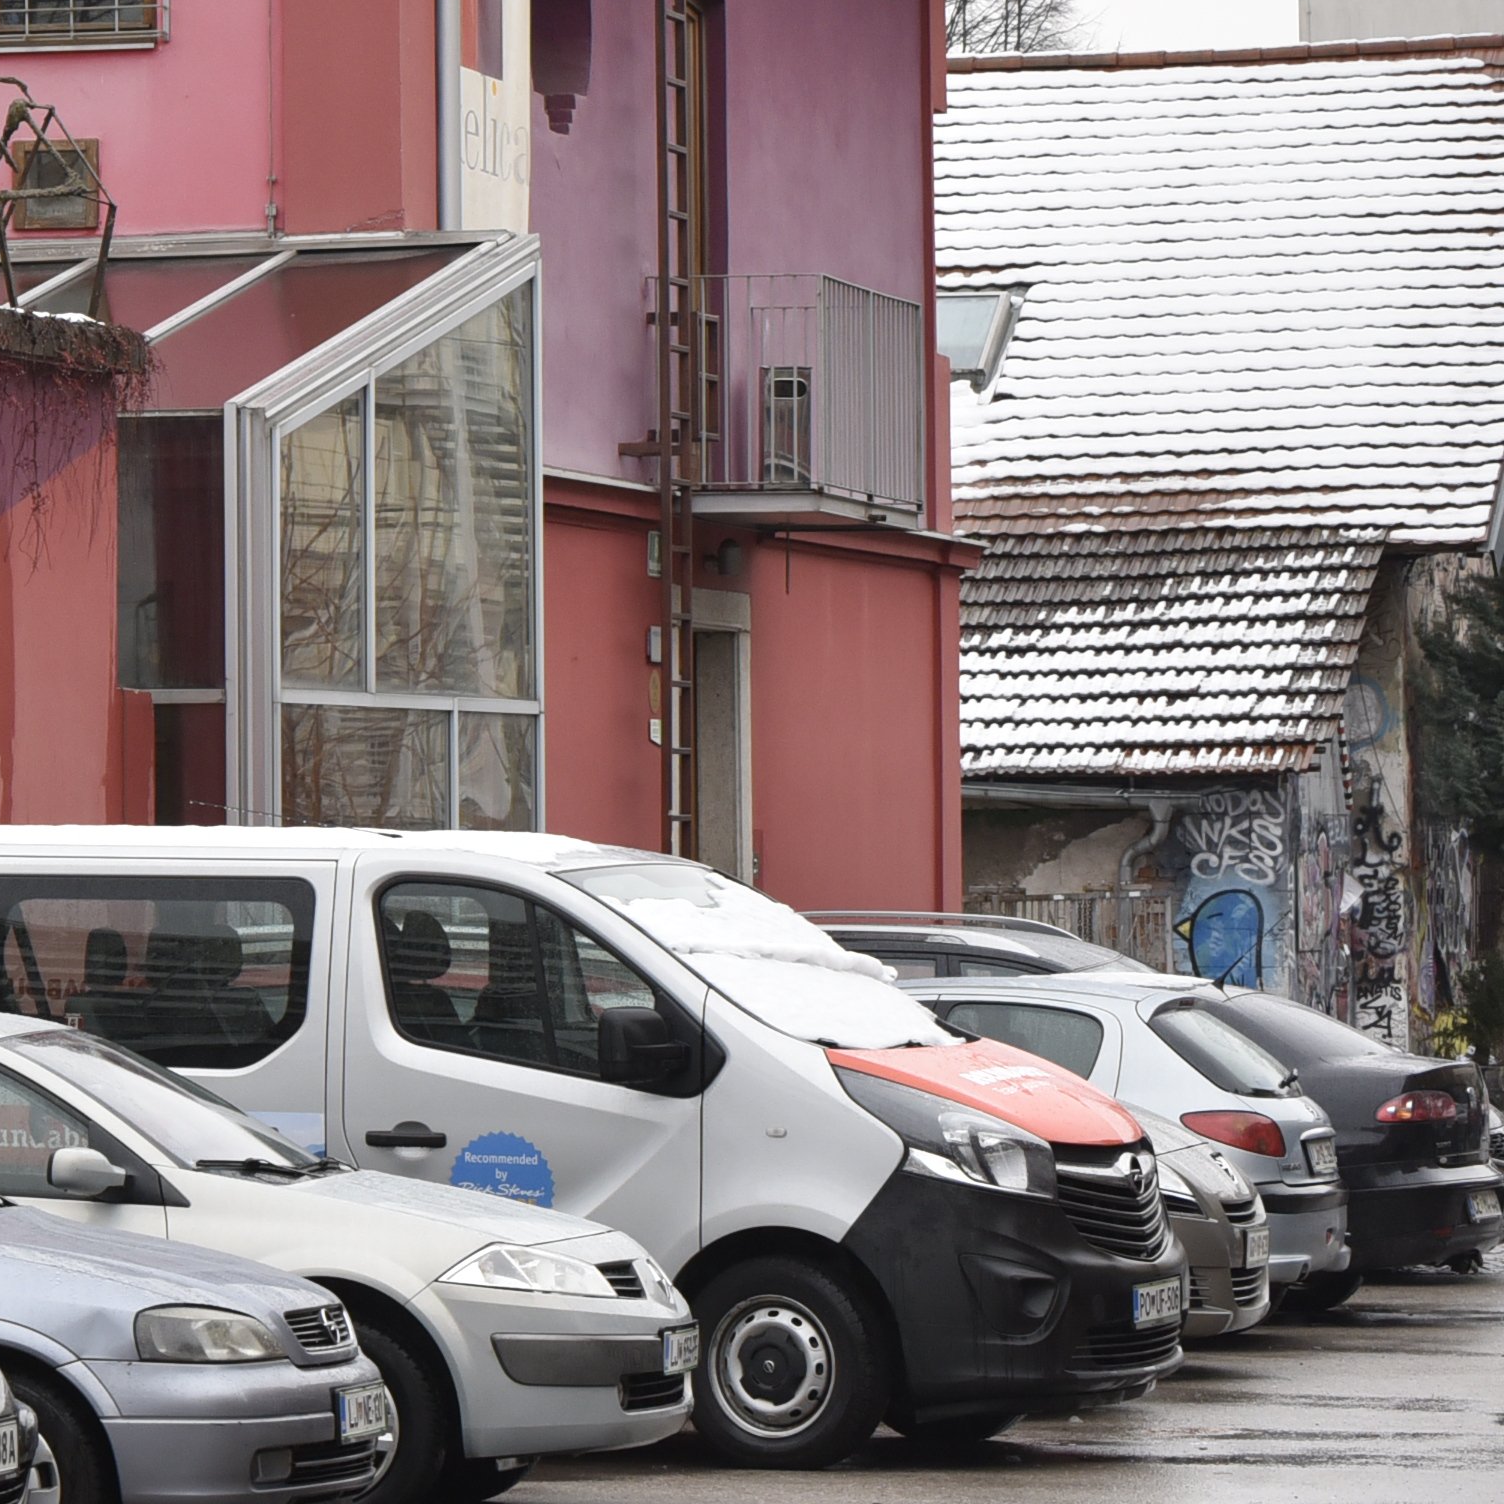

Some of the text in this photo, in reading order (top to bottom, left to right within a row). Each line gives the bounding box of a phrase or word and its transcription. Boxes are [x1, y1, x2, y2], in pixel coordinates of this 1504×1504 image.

[461, 76, 529, 186] elica
[464, 1151, 538, 1165] Recommended
[495, 1168, 508, 1181] by
